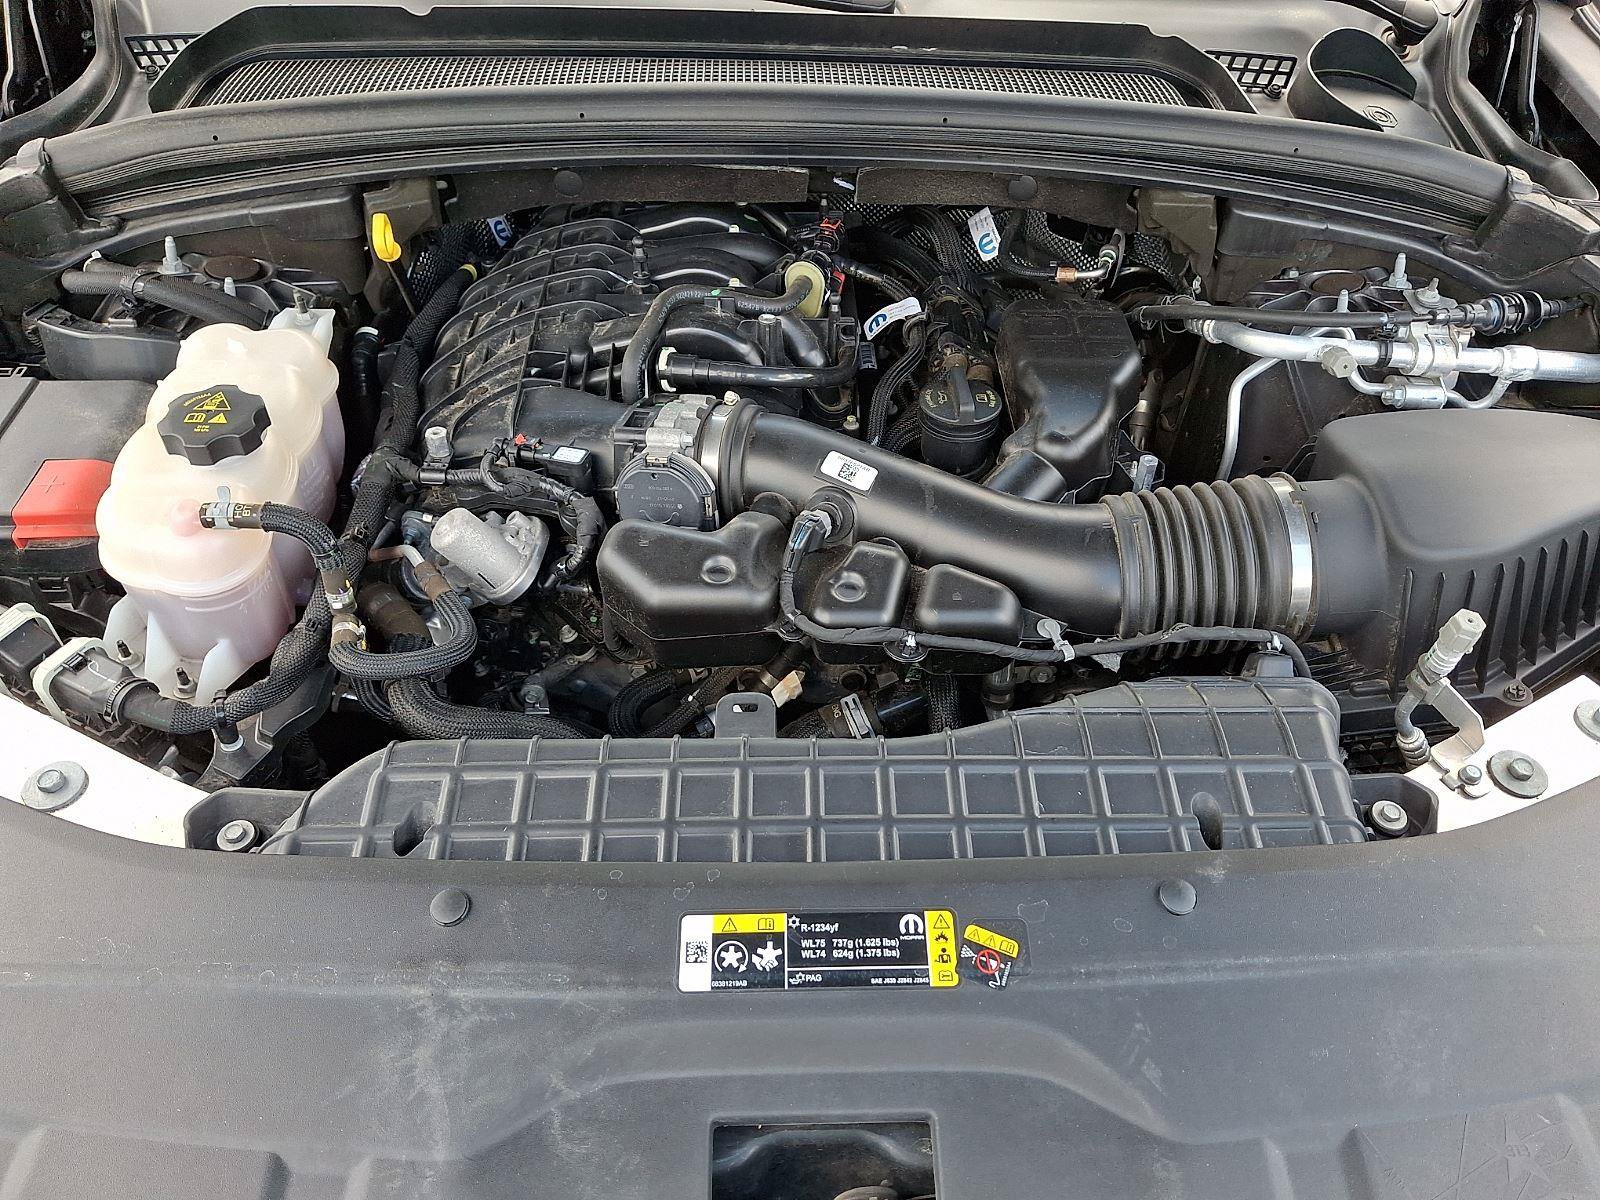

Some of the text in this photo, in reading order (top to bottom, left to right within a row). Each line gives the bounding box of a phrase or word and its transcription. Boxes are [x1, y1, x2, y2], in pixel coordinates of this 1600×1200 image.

[800, 922, 839, 934] R-1234yf
[801, 938, 899, 948] WL75 737g (1.625 lbs)
[801, 948, 900, 959] WL74 624g (1.375 lbs)
[806, 974, 822, 982] PAG
